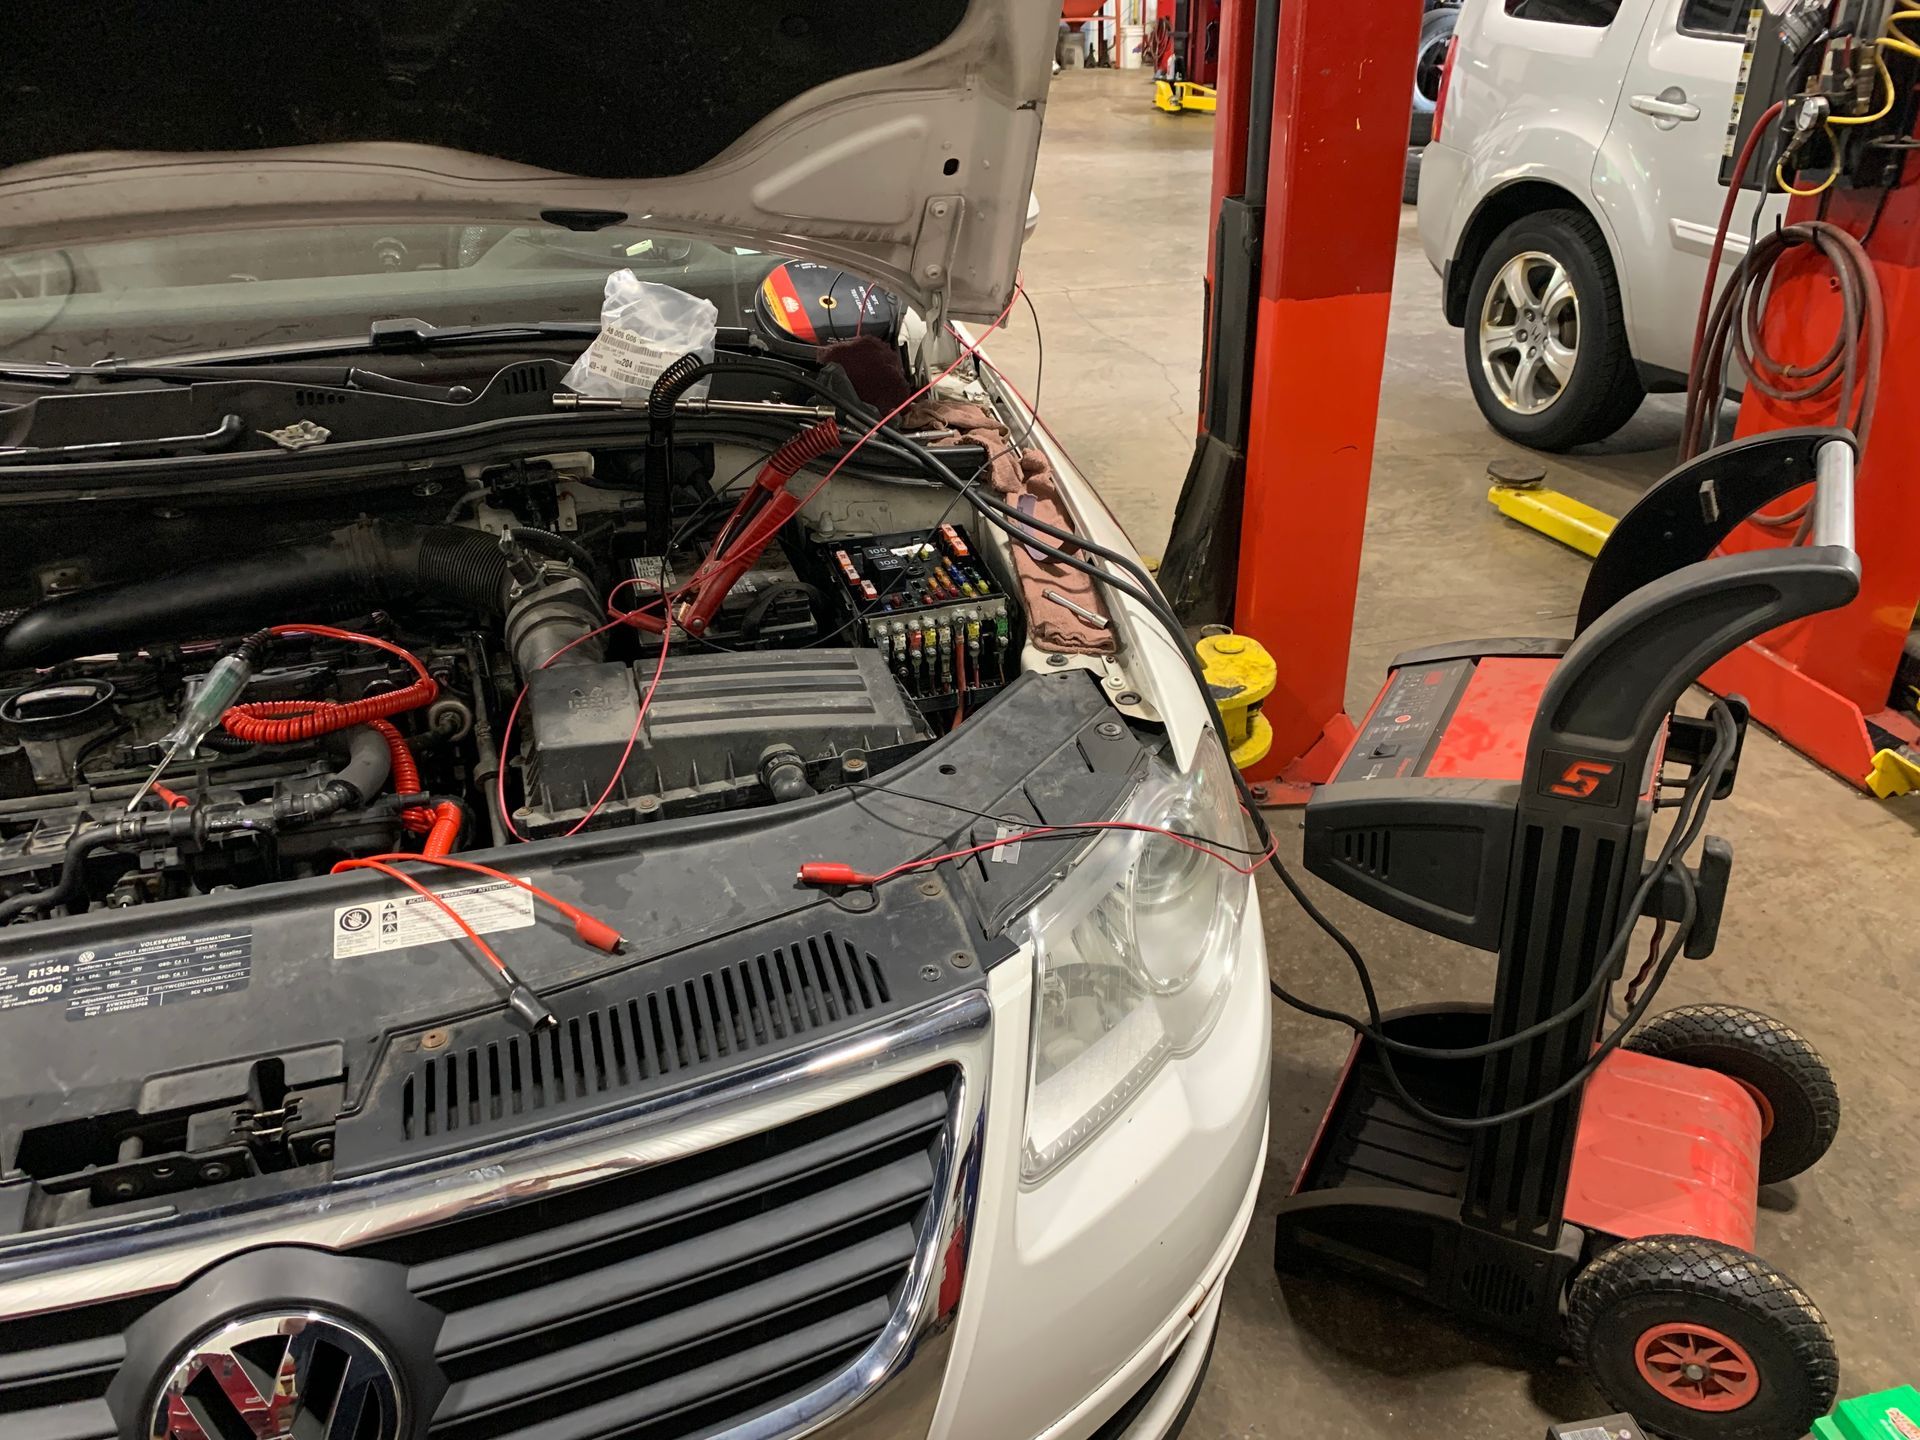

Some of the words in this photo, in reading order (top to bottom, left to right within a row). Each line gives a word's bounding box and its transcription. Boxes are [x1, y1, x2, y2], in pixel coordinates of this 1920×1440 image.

[868, 547, 887, 555] 100
[114, 949, 136, 957] VEHICLE
[138, 945, 164, 953] EMISSION
[193, 934, 231, 943] INFORMATION
[140, 936, 186, 947] VOLKSWAGEN
[219, 949, 243, 957] Gasoline
[218, 961, 242, 970] Gasoline
[28, 965, 70, 979] R134a
[28, 983, 63, 996] 600g
